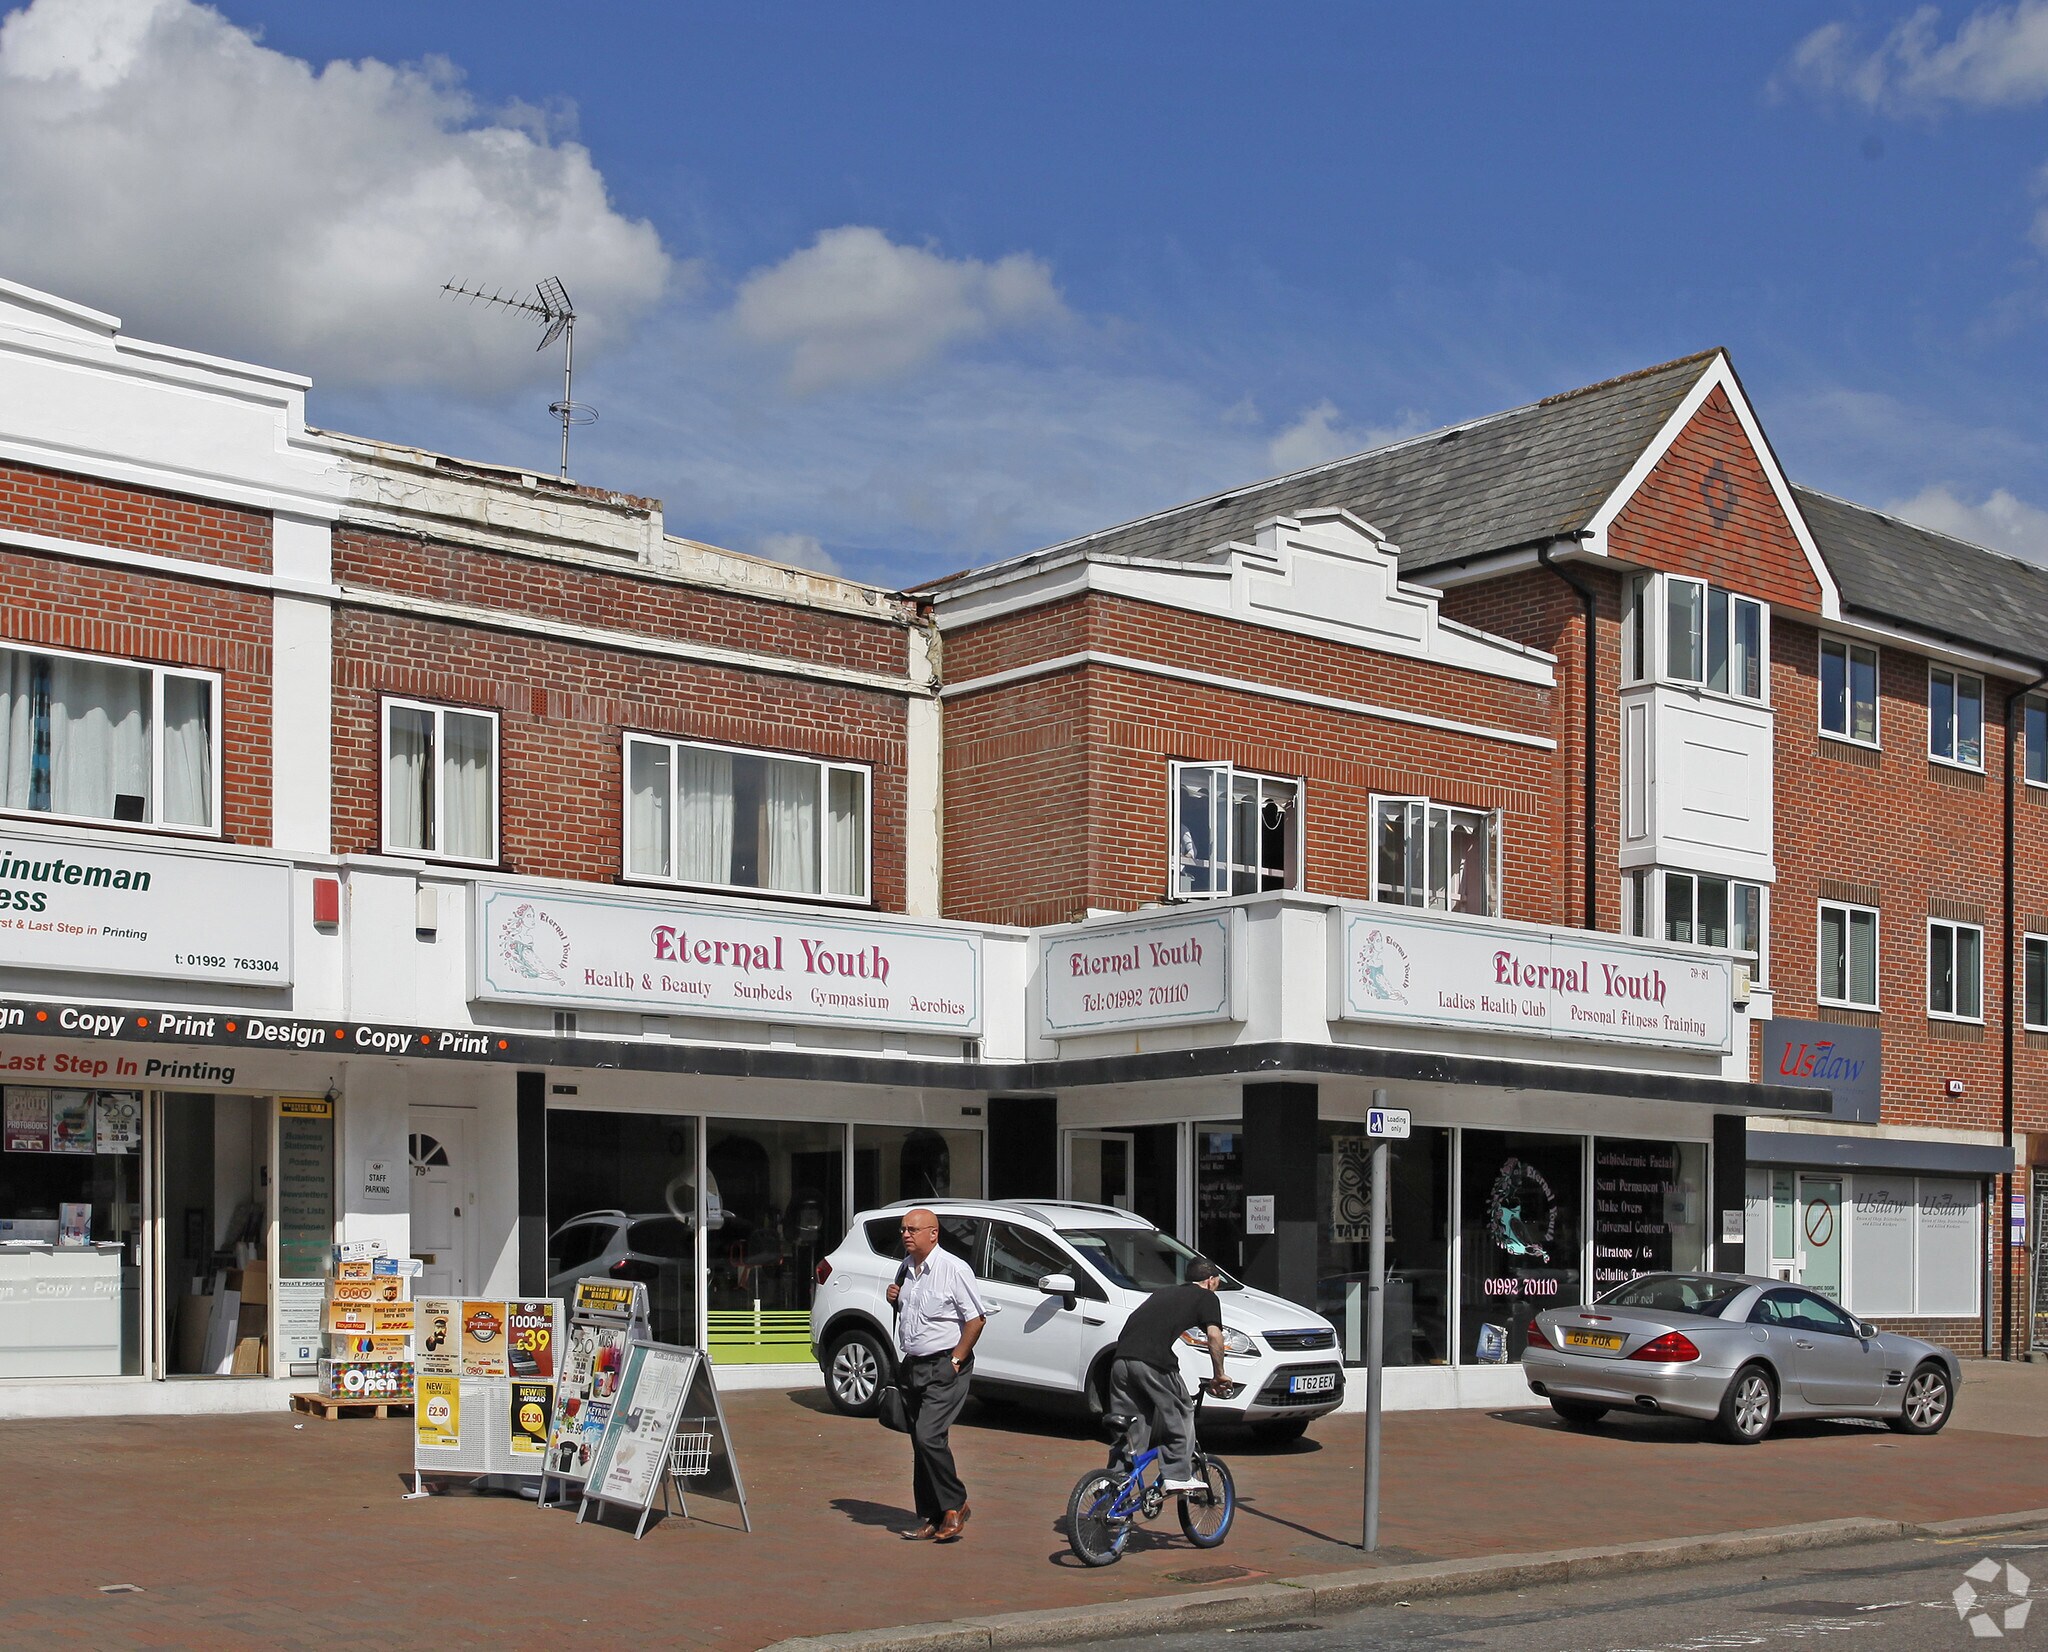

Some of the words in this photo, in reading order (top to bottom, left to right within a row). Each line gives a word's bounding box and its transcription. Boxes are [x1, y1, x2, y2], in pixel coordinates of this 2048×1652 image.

[16, 921, 24, 929] &
[28, 920, 53, 932] Last
[57, 922, 83, 936] Step
[87, 925, 98, 935] in
[102, 926, 148, 941] Printing
[538, 911, 568, 941] Eternal
[175, 954, 183, 965] t:
[187, 954, 226, 968] 01992
[233, 958, 279, 972] 763304
[651, 924, 785, 976] Eternal
[799, 938, 890, 987] Youth
[1070, 945, 1140, 977] Eternal
[1149, 938, 1203, 967] Youth
[1492, 950, 1590, 997] Eternal
[1601, 963, 1667, 1008] Youth
[584, 968, 635, 992] Health
[642, 973, 652, 990] &
[661, 975, 712, 998] Beauty
[733, 981, 792, 1002] Sunbeds
[810, 987, 889, 1011] Gymnasium
[909, 995, 965, 1015] Aerobics
[1148, 983, 1188, 1006] 701110
[1438, 991, 1475, 1010] Ladies
[1481, 995, 1517, 1017] Health
[1521, 1000, 1546, 1017] Club
[1571, 1004, 1616, 1026] Personal
[1621, 1009, 1658, 1030] Fitness
[1662, 1014, 1706, 1037] Training
[59, 1009, 125, 1036] Copy
[158, 1014, 215, 1038] Print
[246, 1020, 326, 1048] Design
[355, 1026, 413, 1054] Copy
[438, 1033, 490, 1054] Print
[1778, 1040, 1866, 1082] Usdaw
[0, 1053, 46, 1071] Last
[54, 1054, 108, 1077] Step
[116, 1056, 138, 1075] In
[145, 1059, 236, 1085] Printing
[7, 1121, 48, 1130] PHOTOBOOKS
[1386, 1115, 1407, 1125] Loading
[288, 1158, 320, 1166] Posters
[369, 1174, 387, 1182] STAFF
[365, 1185, 390, 1194] PARKING
[1596, 1178, 1616, 1192] Semi
[1619, 1180, 1658, 1194] Permanent
[1596, 1199, 1618, 1213] Make
[1621, 1201, 1642, 1214] Overs
[1856, 1190, 1907, 1214] Usdaw
[1921, 1193, 1969, 1216] Usdaw
[283, 1206, 305, 1215] Price
[306, 1206, 325, 1215] Lists
[1250, 1214, 1270, 1222] Parking
[1336, 1224, 1391, 1238] TATTS
[1596, 1219, 1632, 1233] Universal
[1635, 1221, 1665, 1234] Contour
[1596, 1246, 1632, 1259] Ultratone
[344, 1269, 367, 1277] FedEx
[1595, 1267, 1629, 1281] Cellulite
[36, 1281, 73, 1296] Copy
[341, 1289, 370, 1298] TNT
[1484, 1278, 1519, 1295] 01992
[1523, 1278, 1557, 1295] 701110
[337, 1322, 352, 1330] Royal
[509, 1315, 537, 1328] 1000
[516, 1329, 550, 1352] £39
[572, 1337, 594, 1354] 250
[1573, 1332, 1589, 1344] G16
[366, 1369, 396, 1379] We're
[343, 1369, 397, 1396] Open
[426, 1382, 442, 1390] NEW
[1295, 1377, 1317, 1390] LT62
[1318, 1375, 1334, 1388] EEX
[520, 1388, 536, 1396] NEW
[428, 1406, 448, 1417] £2.90
[521, 1413, 542, 1423] £2.90
